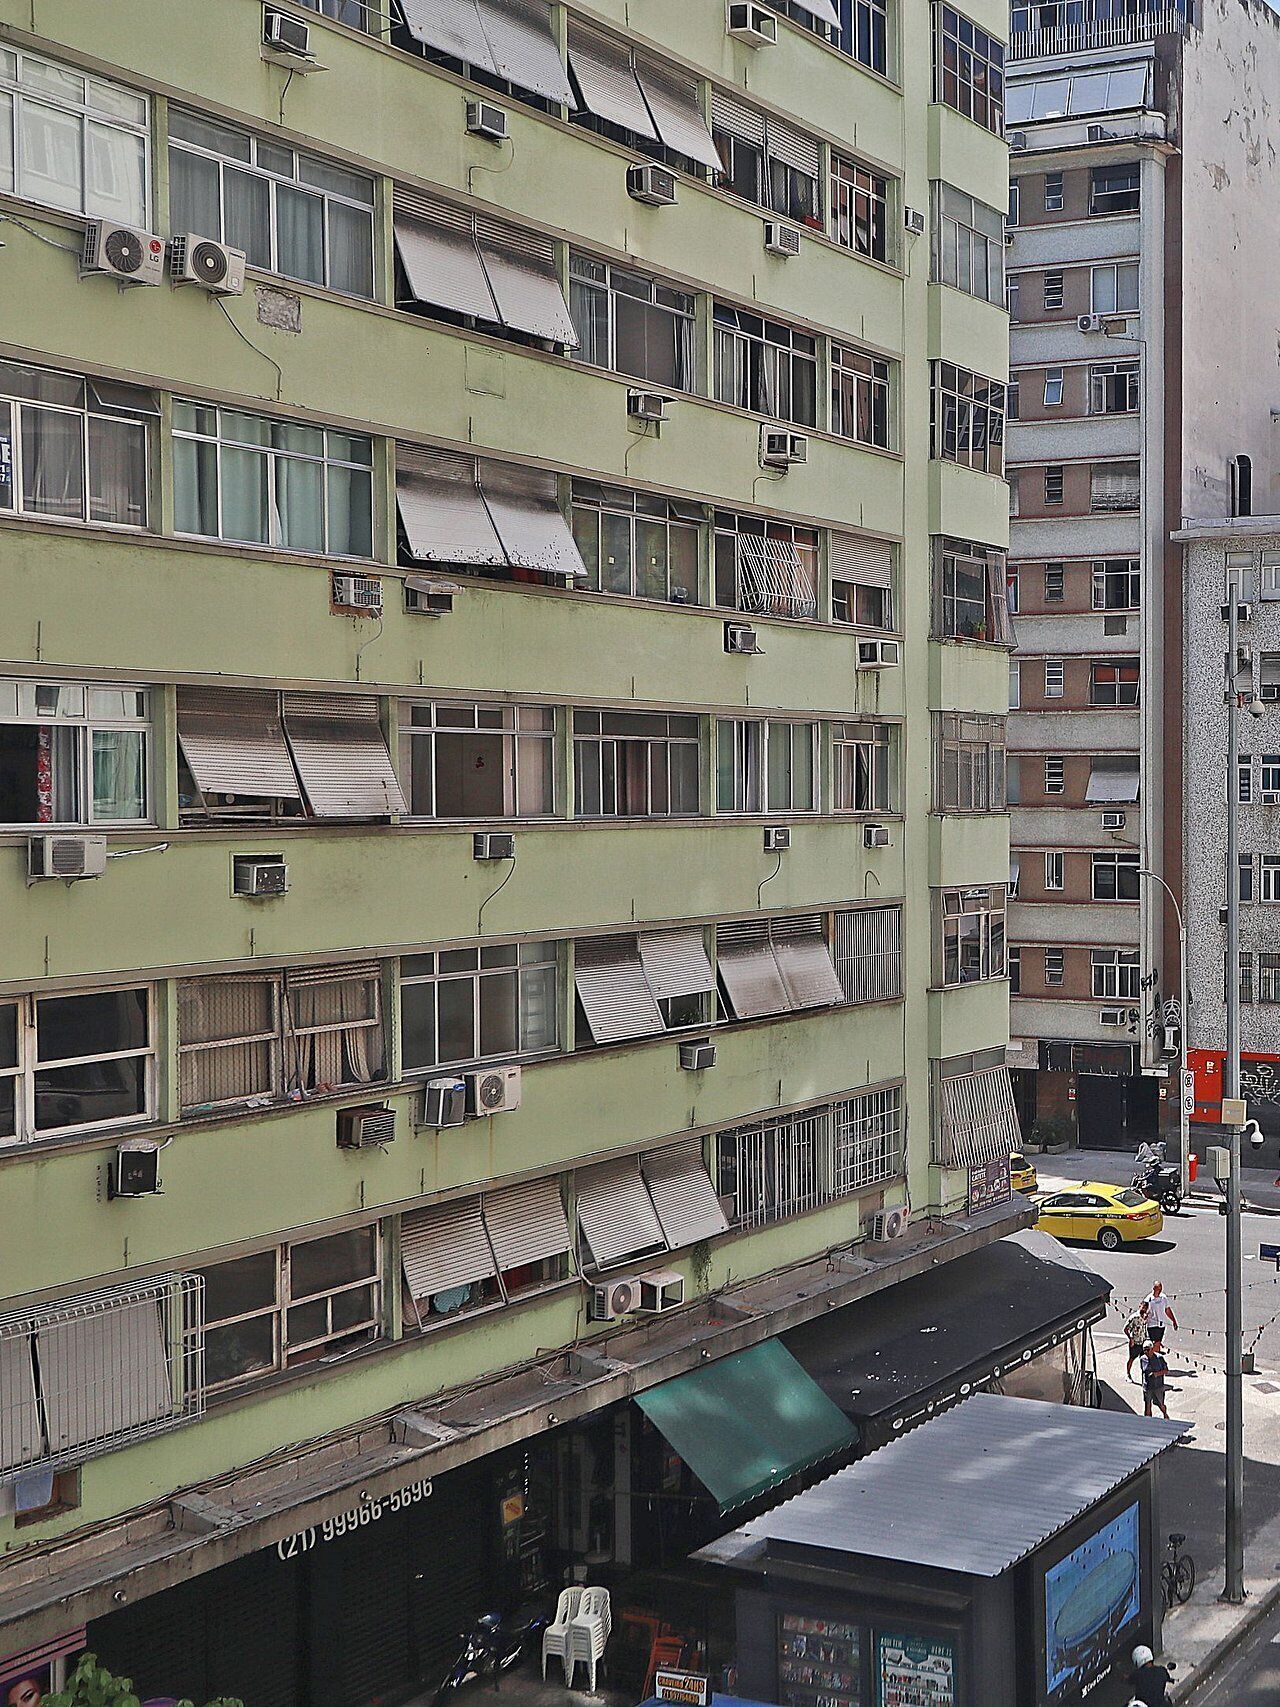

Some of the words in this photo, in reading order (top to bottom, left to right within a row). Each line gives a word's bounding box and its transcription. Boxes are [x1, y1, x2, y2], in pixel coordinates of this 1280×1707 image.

[150, 253, 159, 262] LG
[278, 1526, 316, 1561] (21)
[321, 1477, 433, 1542] 99966-5696
